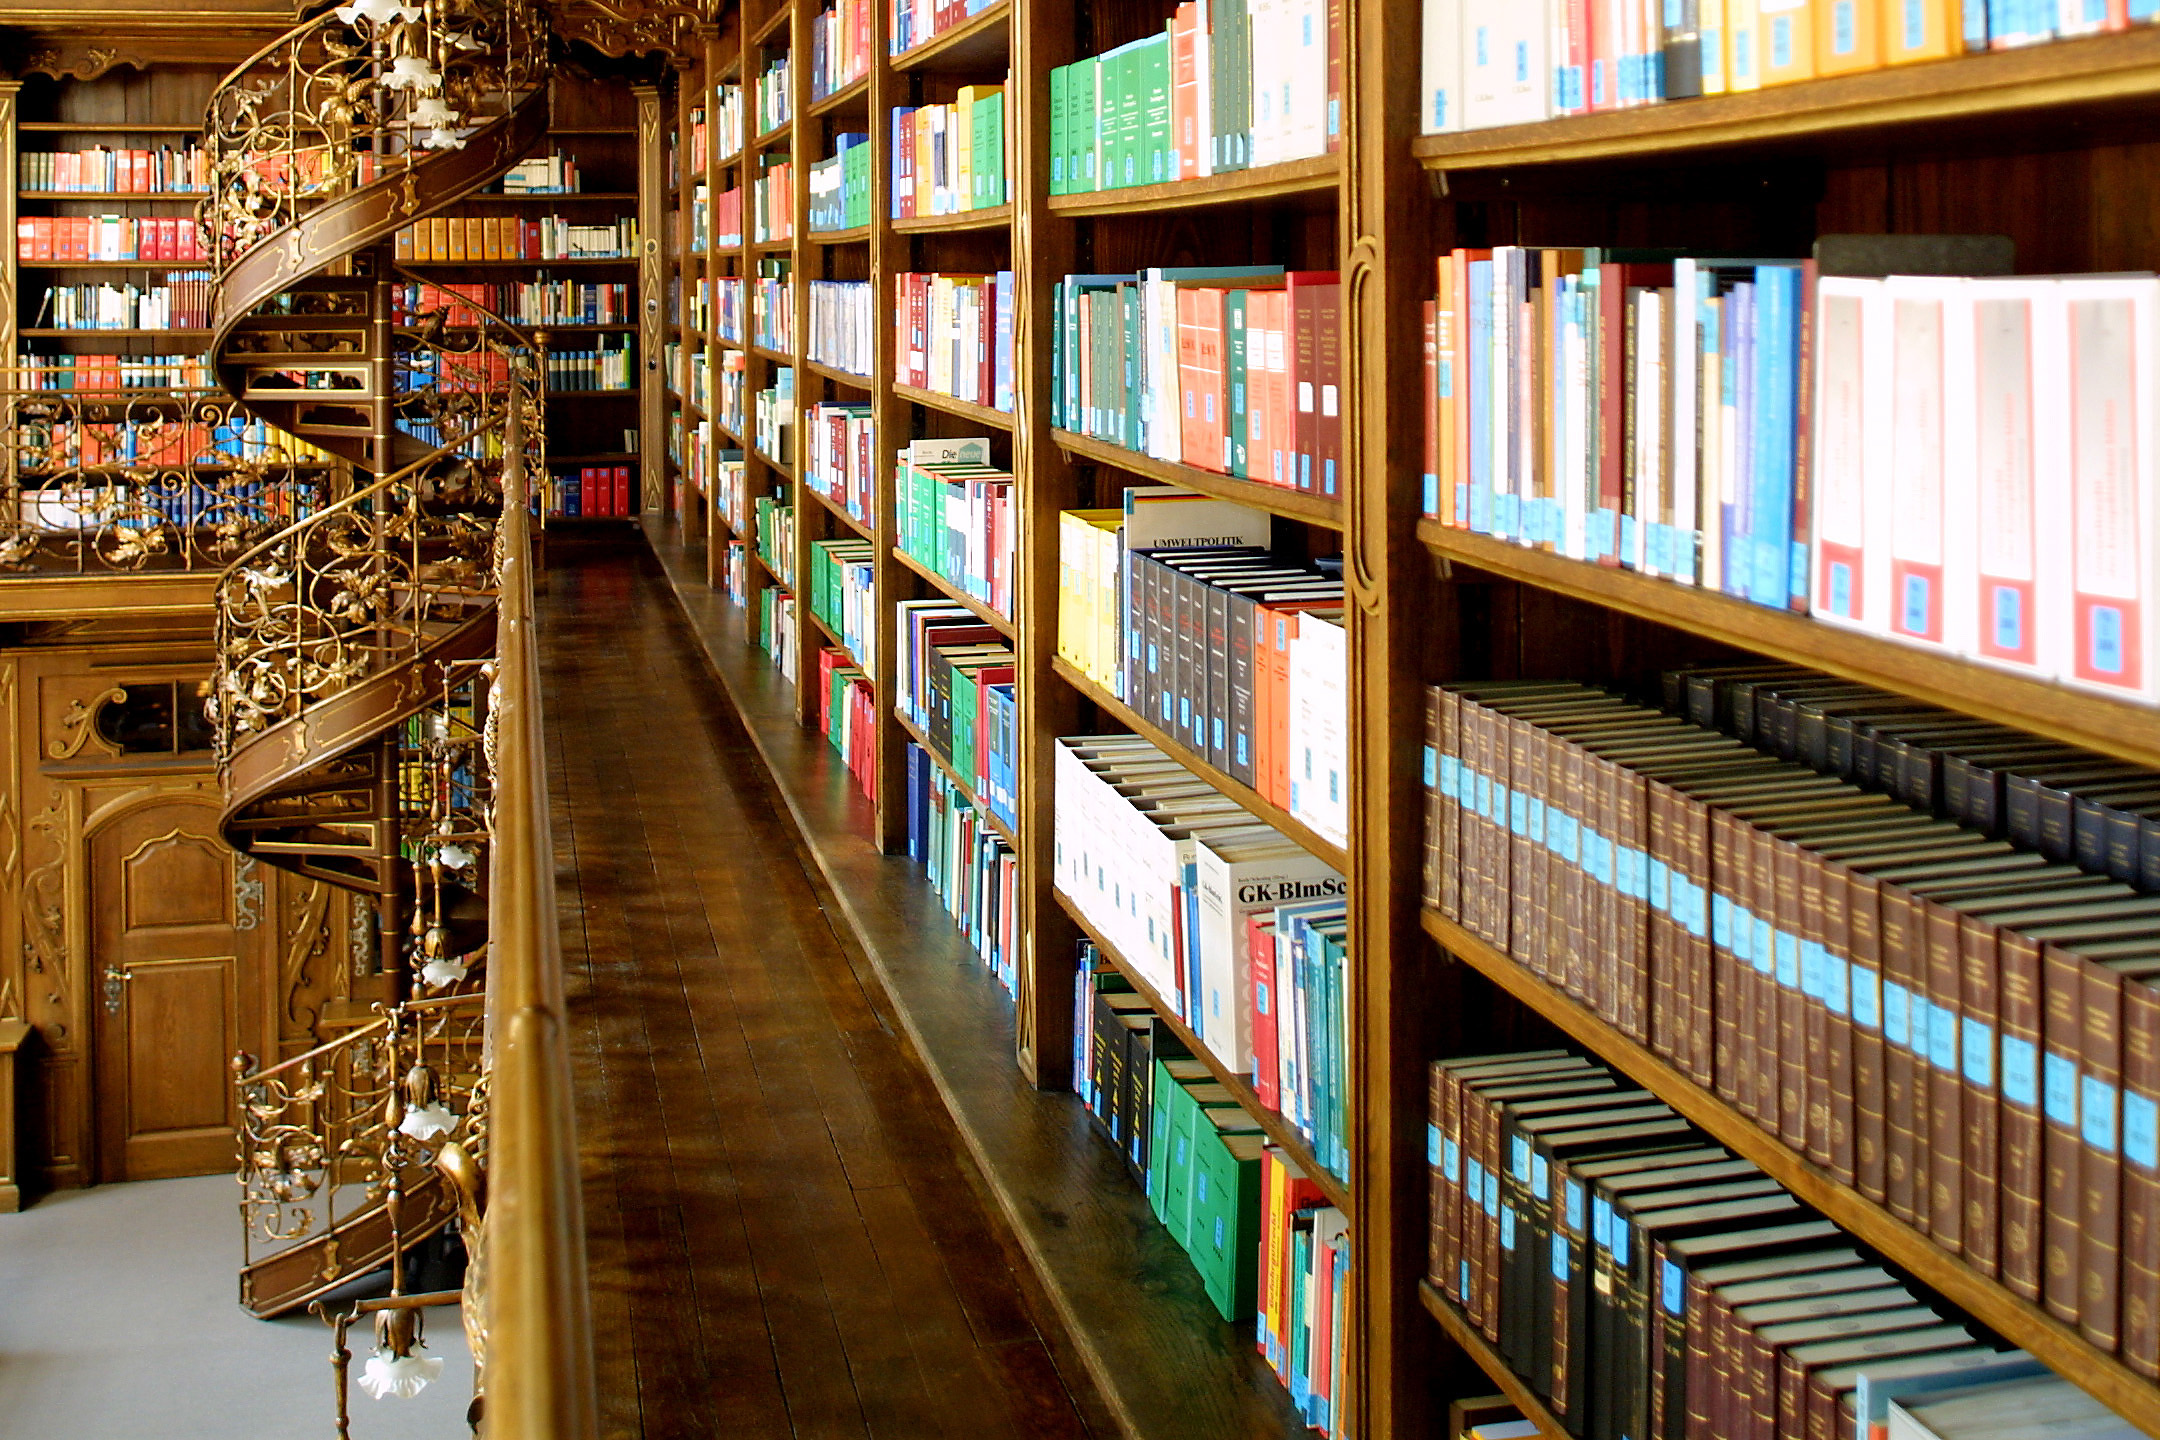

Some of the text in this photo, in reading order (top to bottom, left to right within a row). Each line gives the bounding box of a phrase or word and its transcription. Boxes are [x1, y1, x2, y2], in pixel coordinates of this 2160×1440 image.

[942, 449, 957, 459] Die
[960, 451, 980, 459] neue
[1153, 536, 1244, 548] UMWELTPOLITIK
[1268, 1211, 1277, 1309] Gefahrgutrecht
